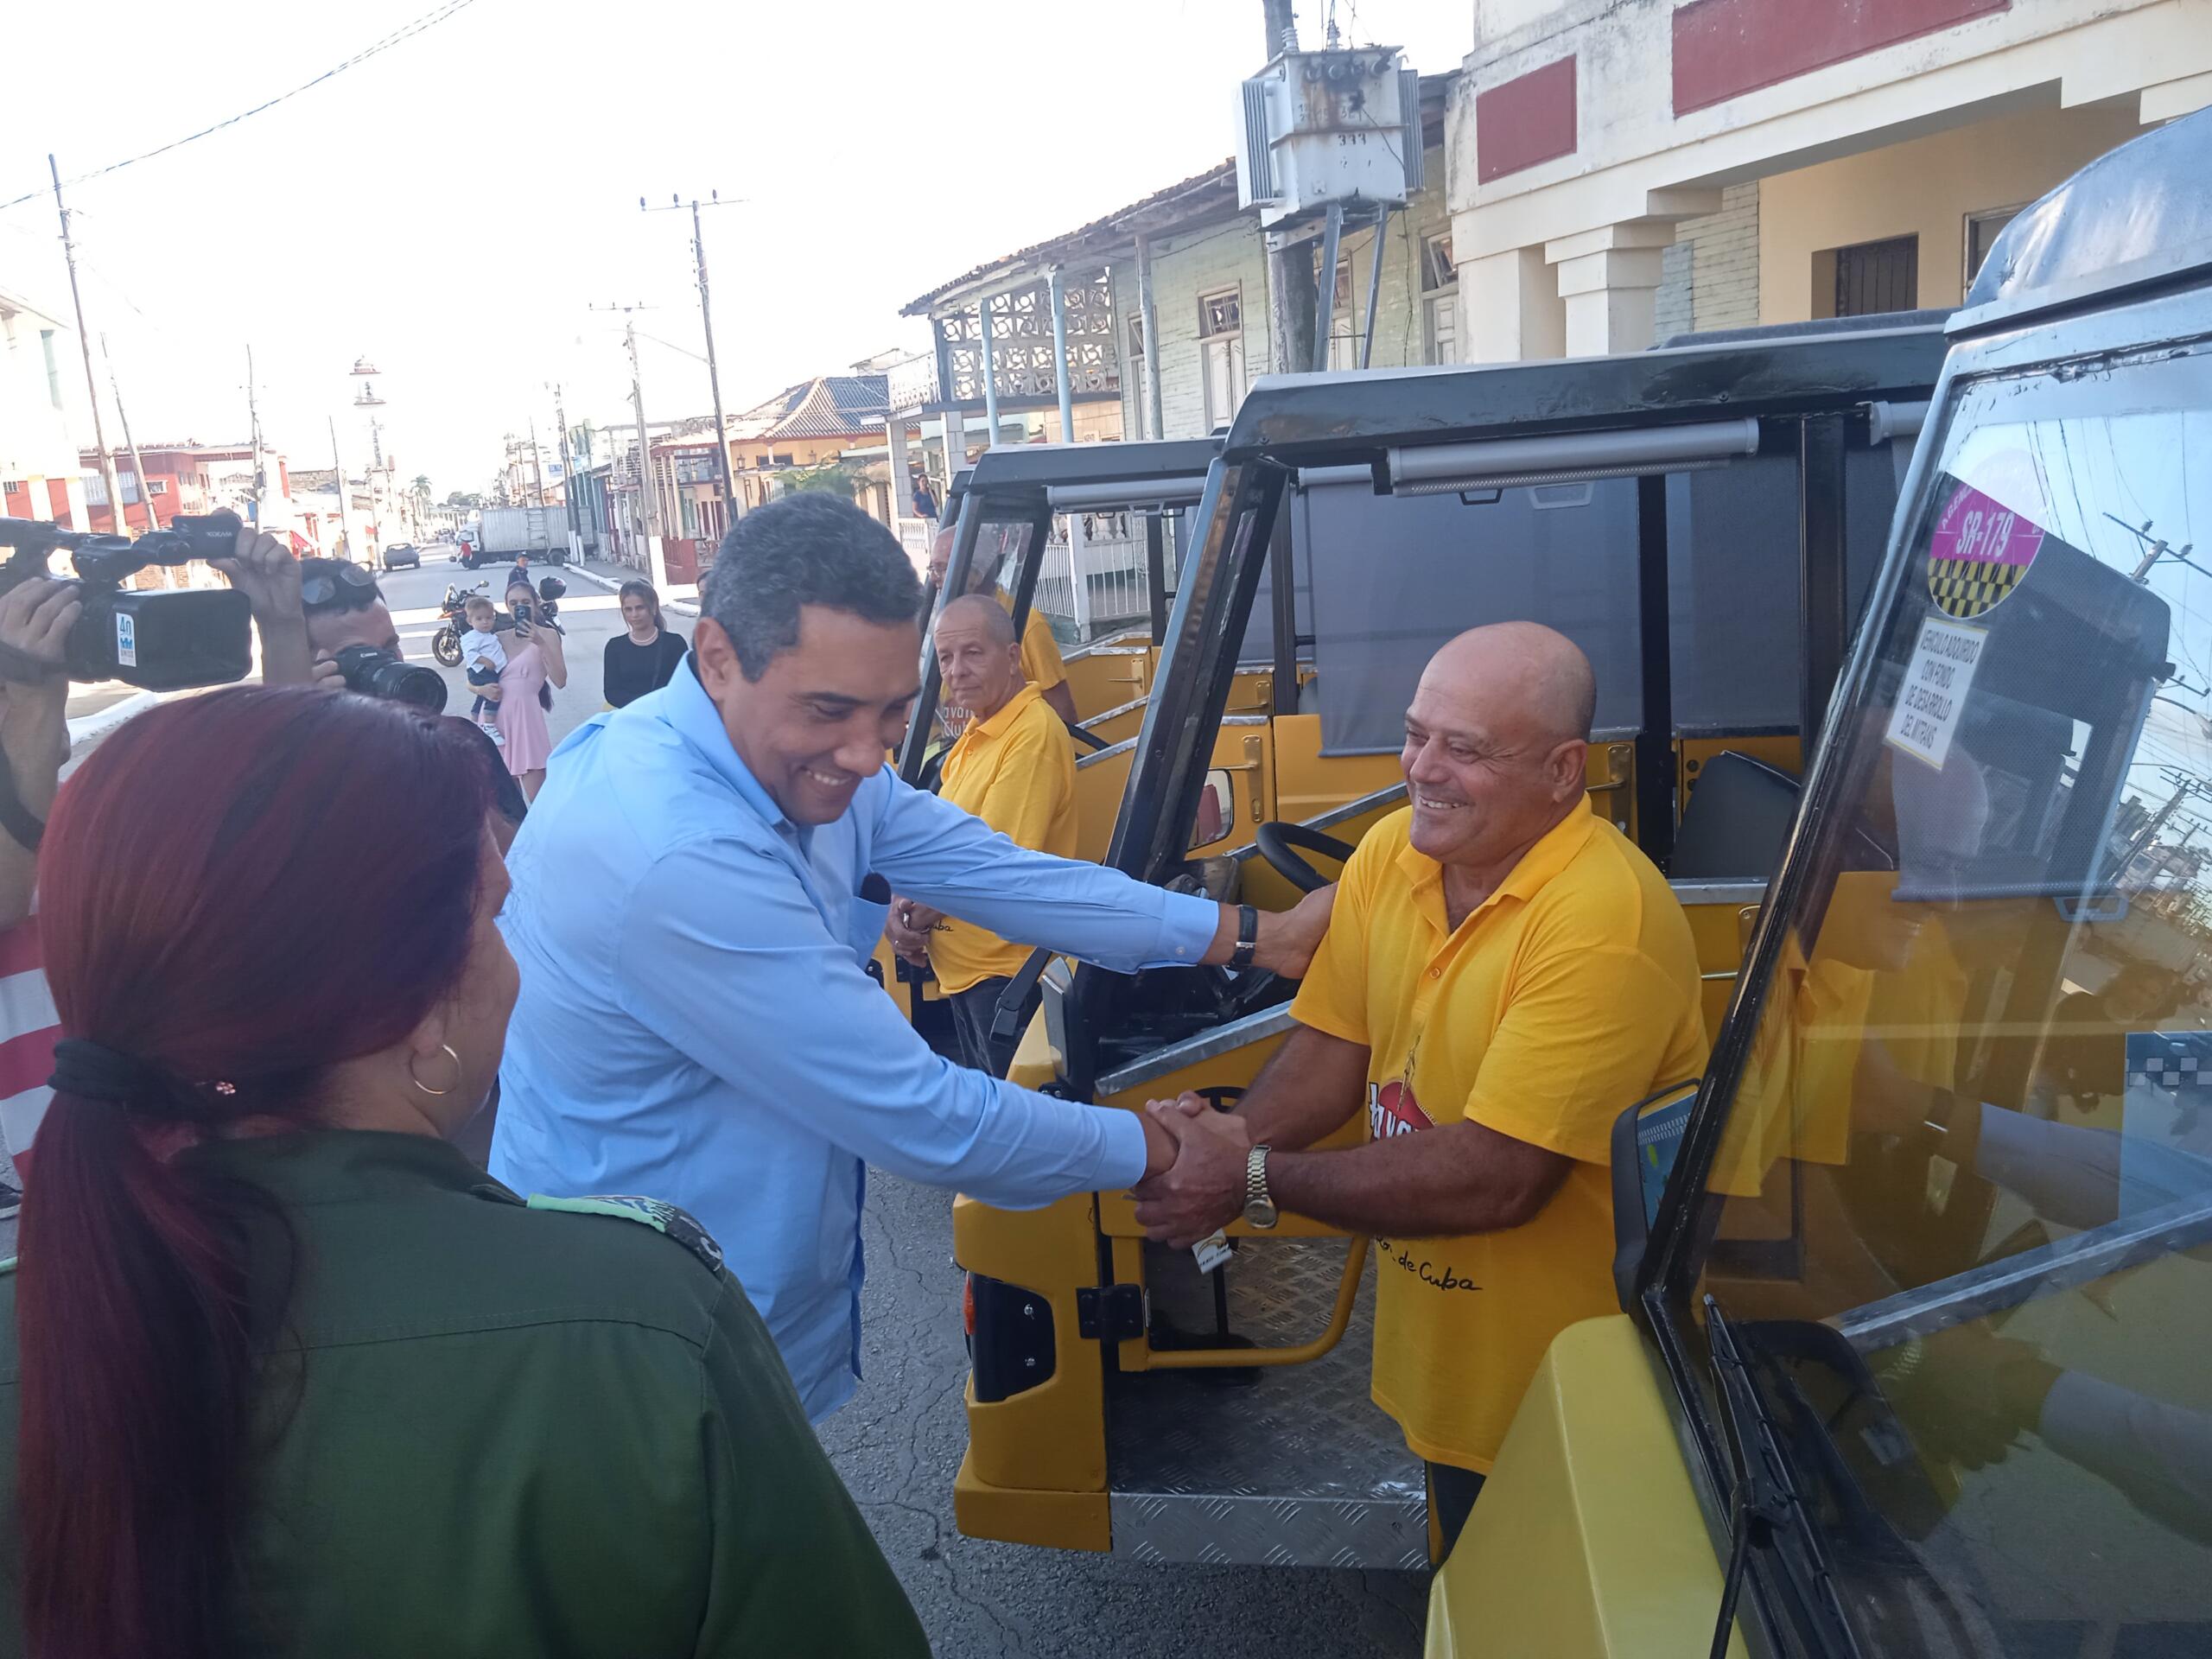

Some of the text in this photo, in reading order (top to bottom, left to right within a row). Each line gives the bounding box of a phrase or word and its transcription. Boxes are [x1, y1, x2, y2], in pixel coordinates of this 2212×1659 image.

[1955, 510, 2015, 557] SR-179
[1920, 658, 1956, 690] CON FONDO
[1904, 683, 1953, 723] DE DESARROLLO
[1899, 713, 1915, 737] DEL
[1398, 1251, 1417, 1272] de
[1419, 1262, 1484, 1291] Cuba
